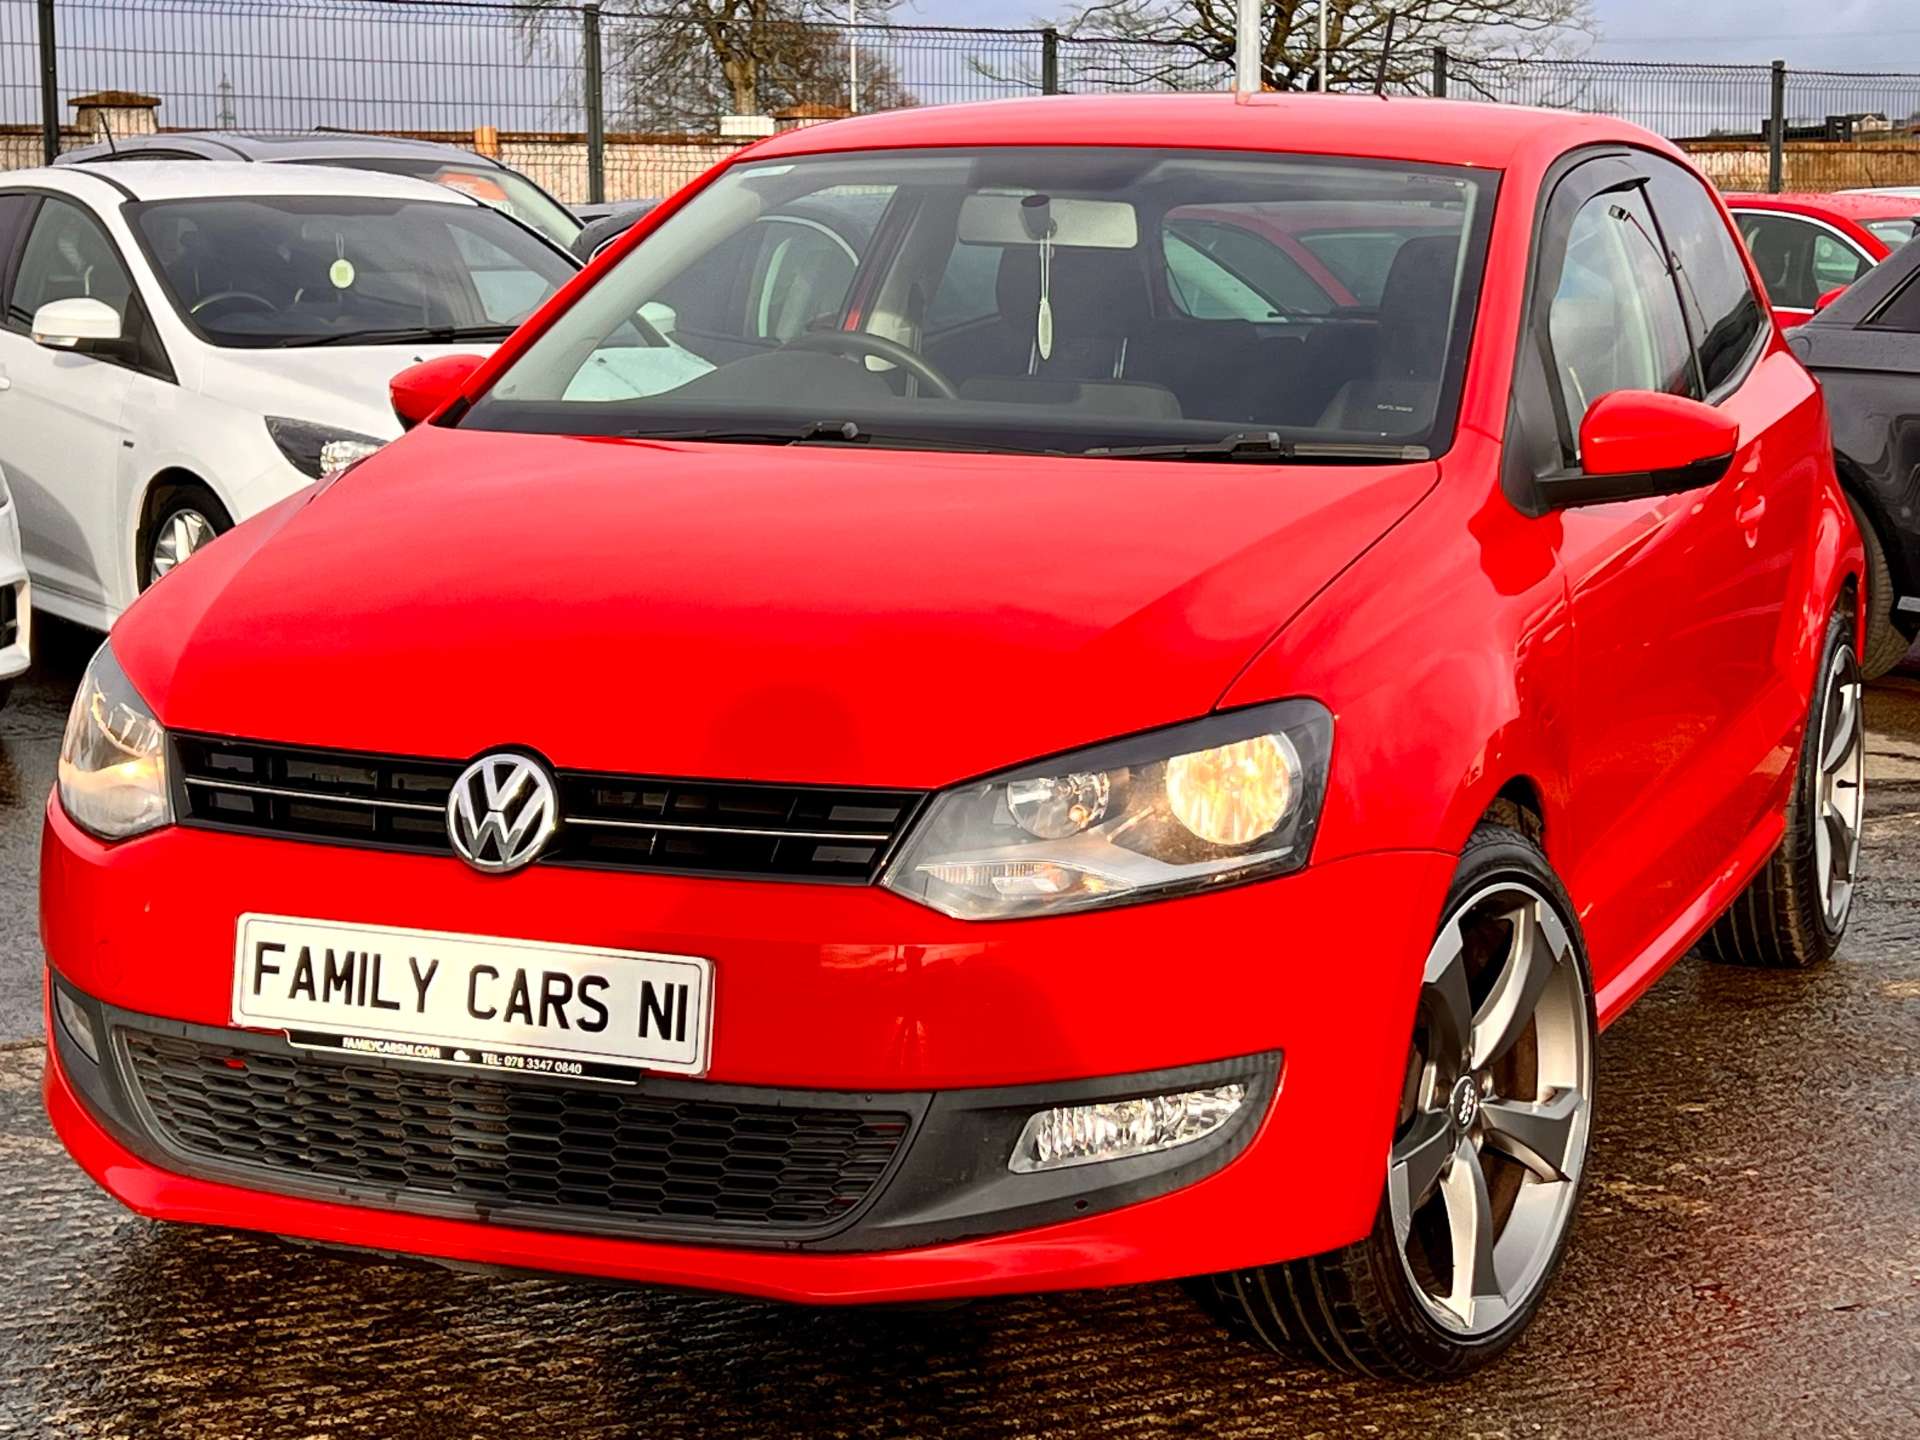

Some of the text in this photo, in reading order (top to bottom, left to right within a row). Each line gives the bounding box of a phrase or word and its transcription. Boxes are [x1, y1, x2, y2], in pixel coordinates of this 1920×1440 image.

[253, 941, 689, 1042] FAMILY CARS NI
[481, 1052, 502, 1066] TEL:
[504, 1055, 525, 1068] 078
[526, 1058, 553, 1071] 3347
[554, 1061, 582, 1075] 0840
